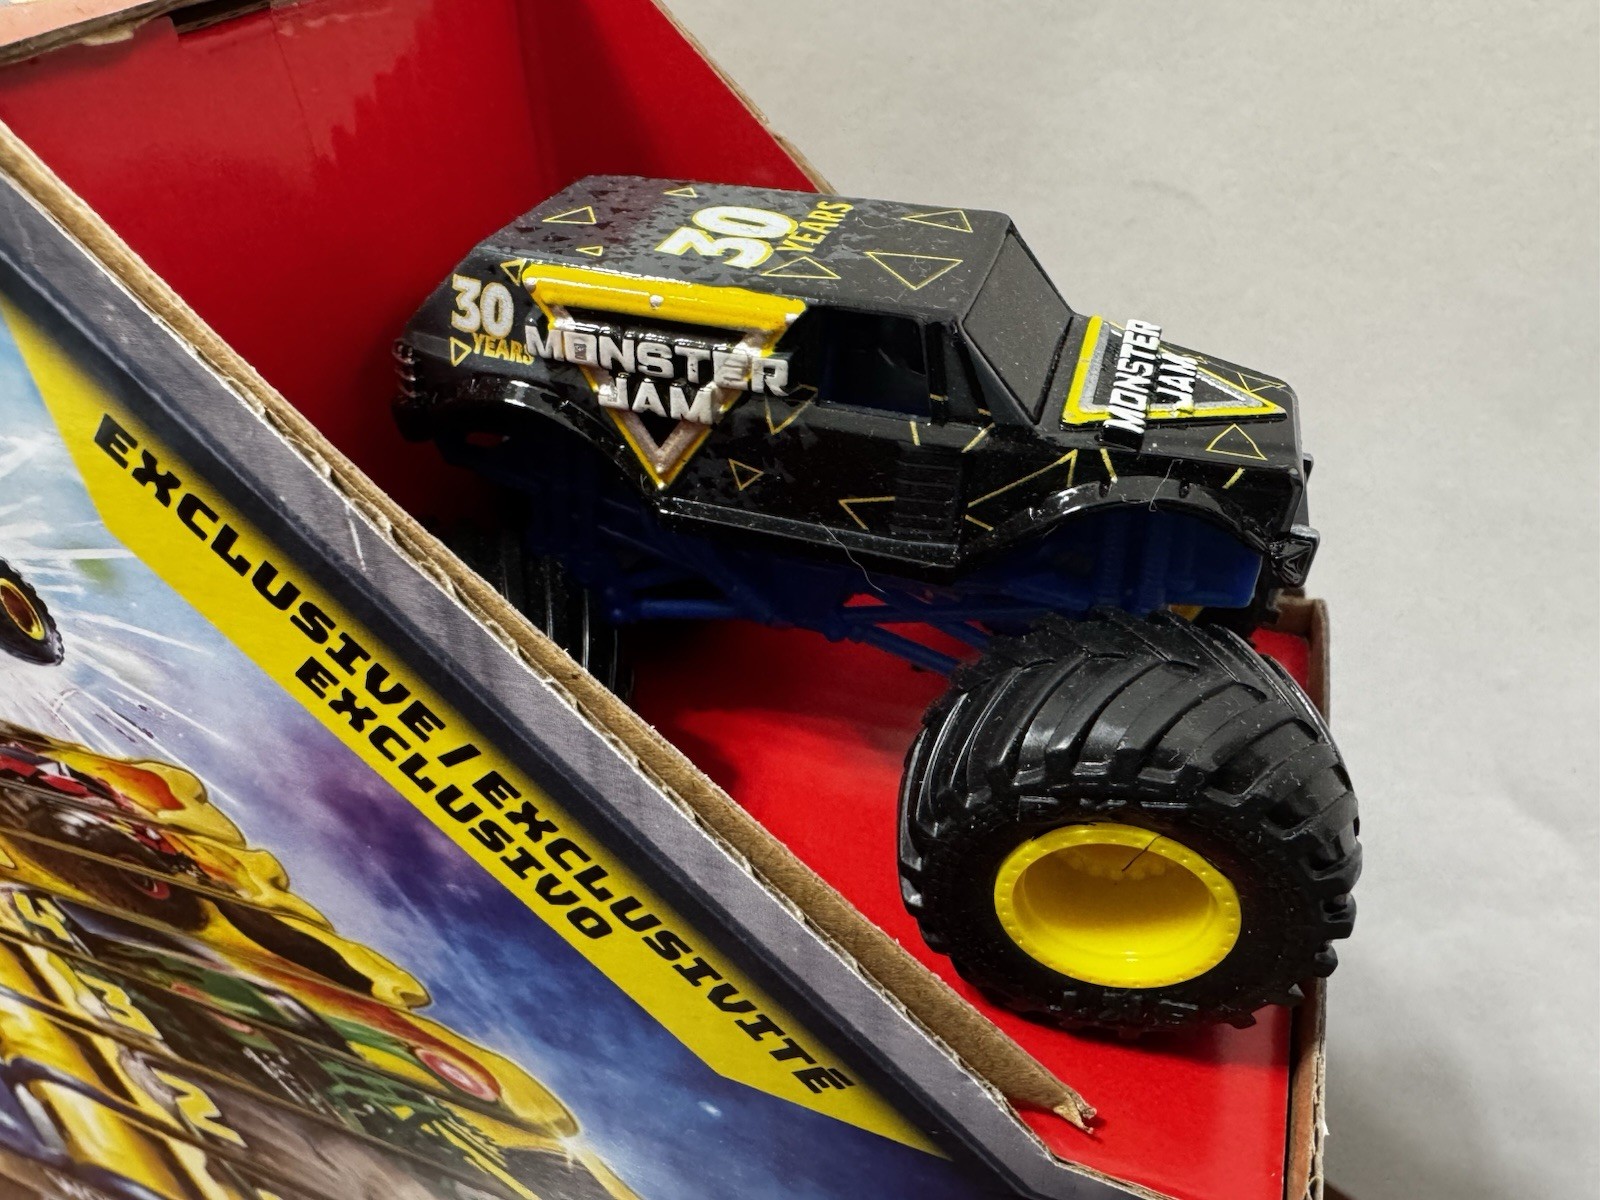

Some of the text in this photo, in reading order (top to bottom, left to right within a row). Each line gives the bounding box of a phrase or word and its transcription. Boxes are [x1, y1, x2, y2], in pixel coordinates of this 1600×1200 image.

[654, 206, 799, 269] 30
[775, 201, 854, 252] YEARS
[451, 274, 515, 339] 30
[472, 331, 535, 366] YEARS
[524, 324, 790, 397] MONSTER
[1103, 319, 1162, 434] MONSTER
[598, 373, 714, 425] JAM
[1156, 353, 1197, 415] JAM
[94, 413, 446, 743] EXCLUSIVE
[472, 769, 856, 1094] EXCLUSIVITÉ
[295, 656, 613, 939] EXCLUSIVO
